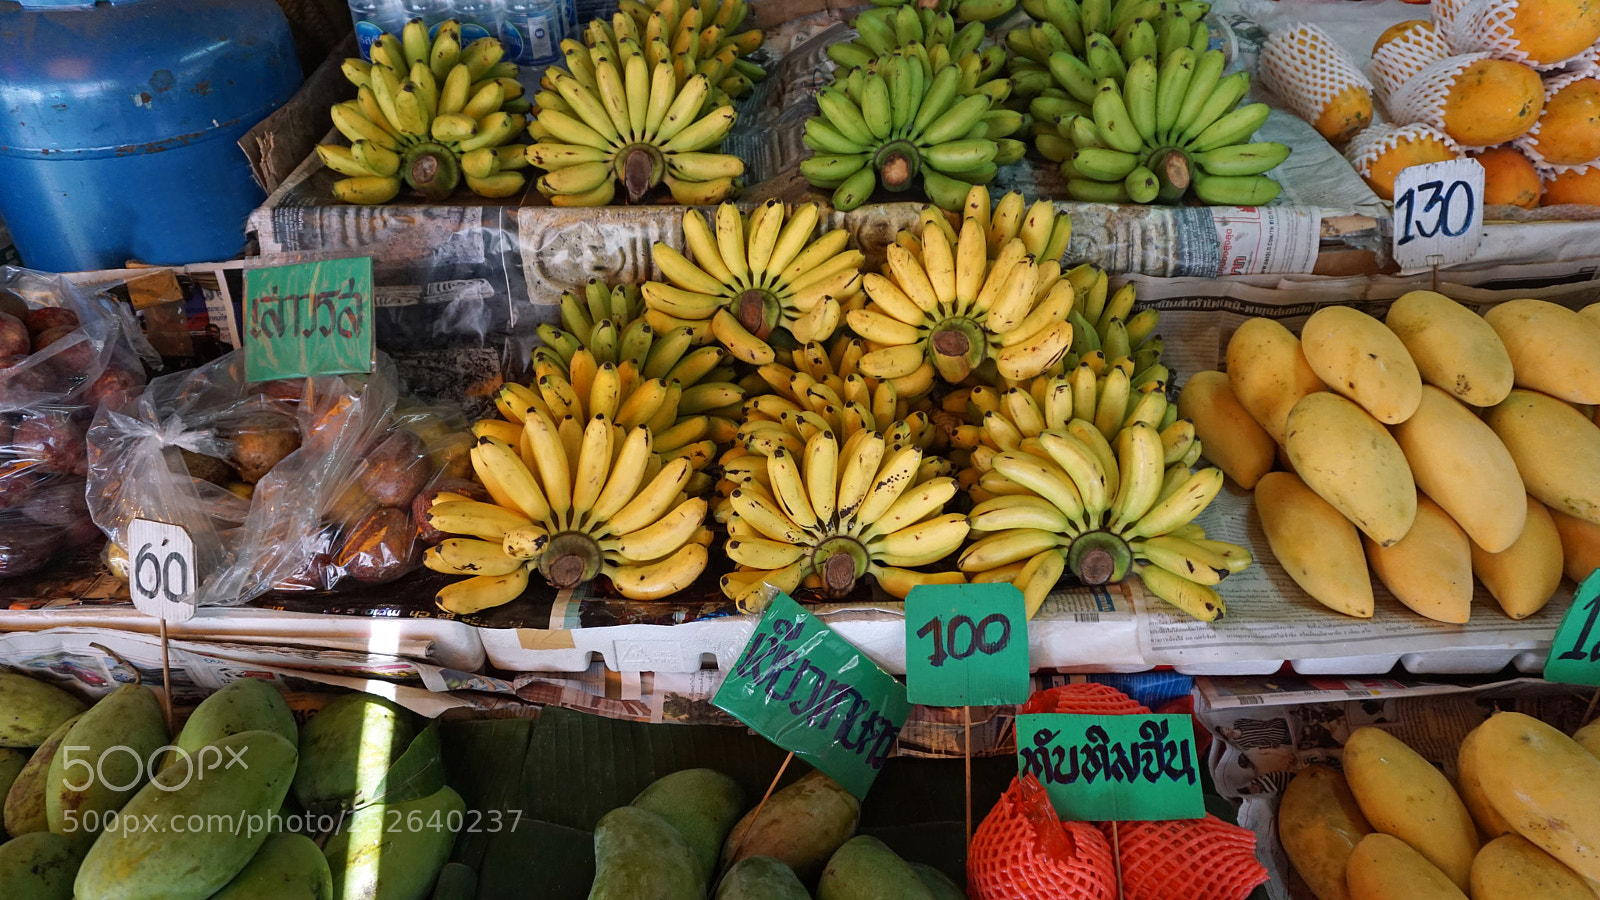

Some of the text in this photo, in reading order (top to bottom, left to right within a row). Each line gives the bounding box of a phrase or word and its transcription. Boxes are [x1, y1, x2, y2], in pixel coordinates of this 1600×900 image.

[1395, 180, 1474, 246] 130
[135, 542, 188, 603] 60
[916, 613, 1011, 667] 100
